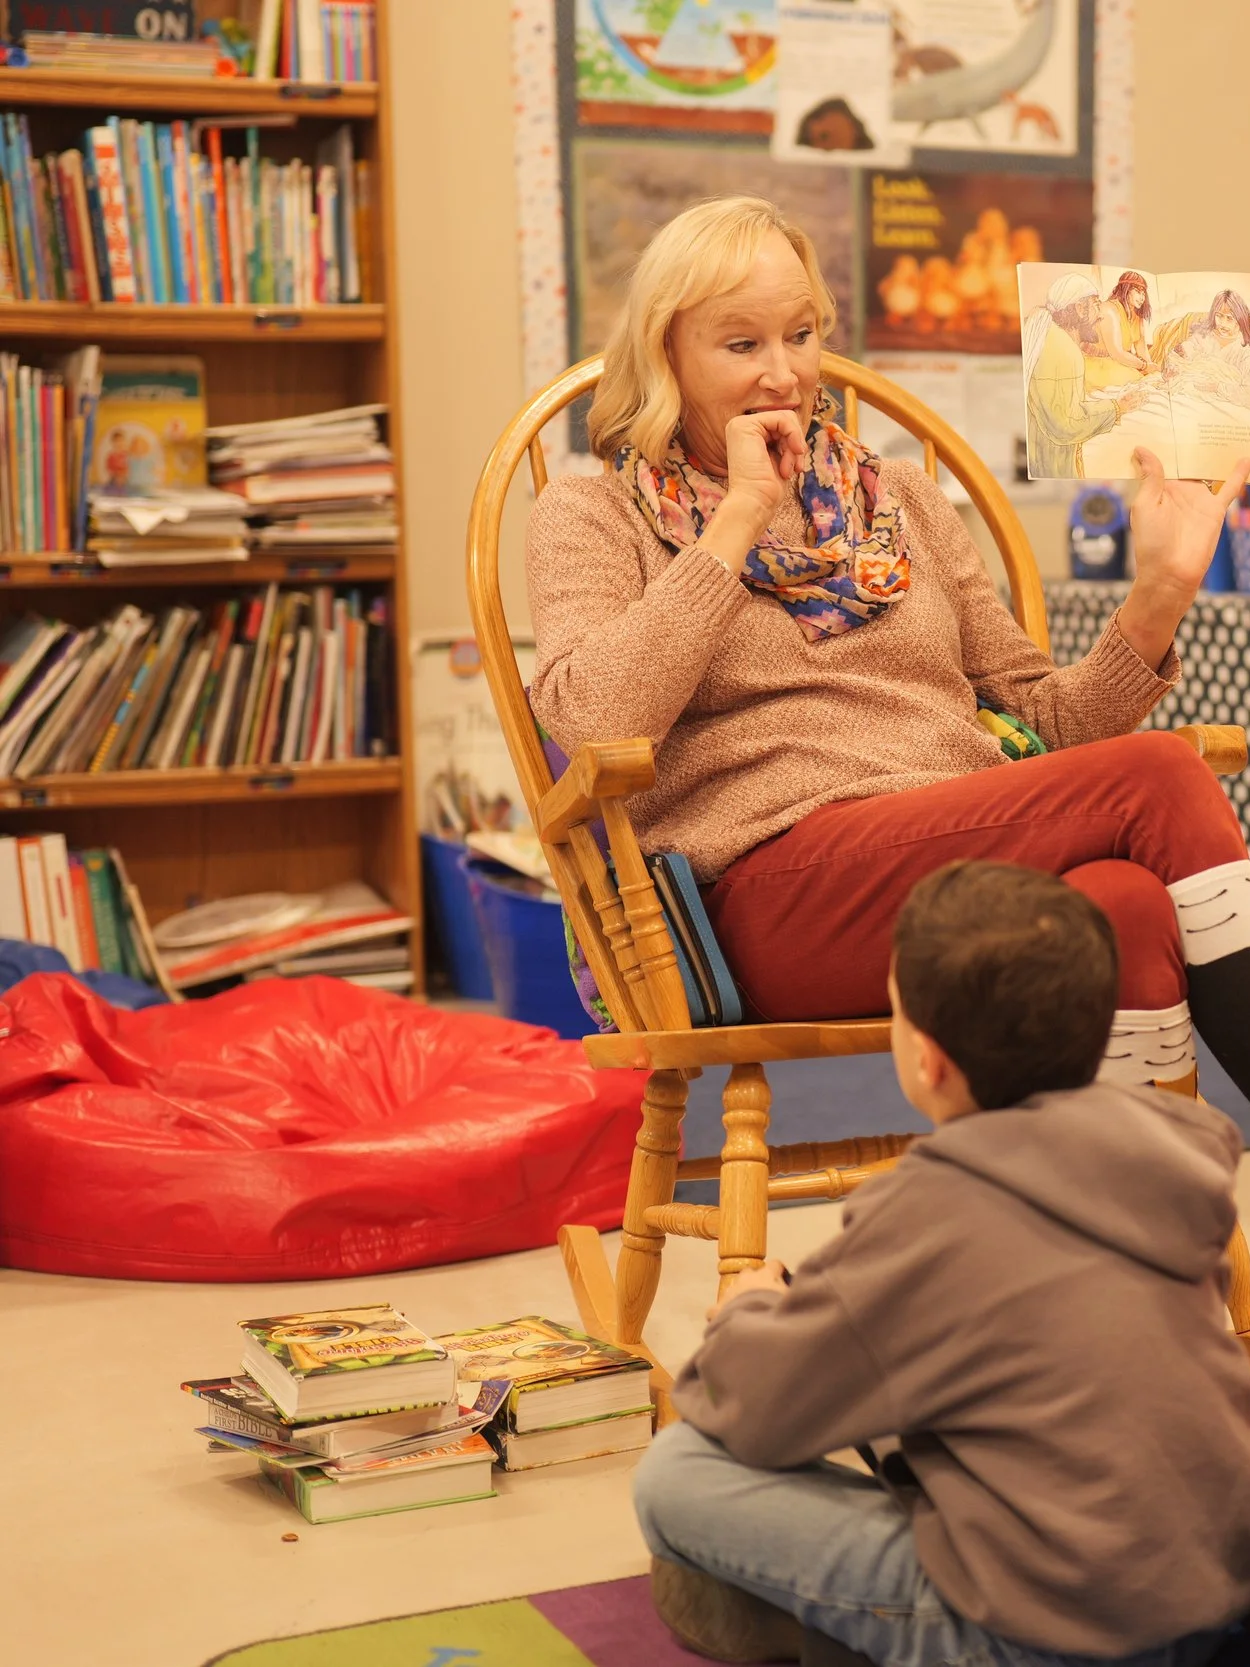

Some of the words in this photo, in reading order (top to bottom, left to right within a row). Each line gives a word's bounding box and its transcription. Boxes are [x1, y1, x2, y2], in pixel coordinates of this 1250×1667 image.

[135, 8, 189, 41] ON
[214, 1415, 237, 1430] FIRST
[238, 1414, 273, 1439] BIBLE
